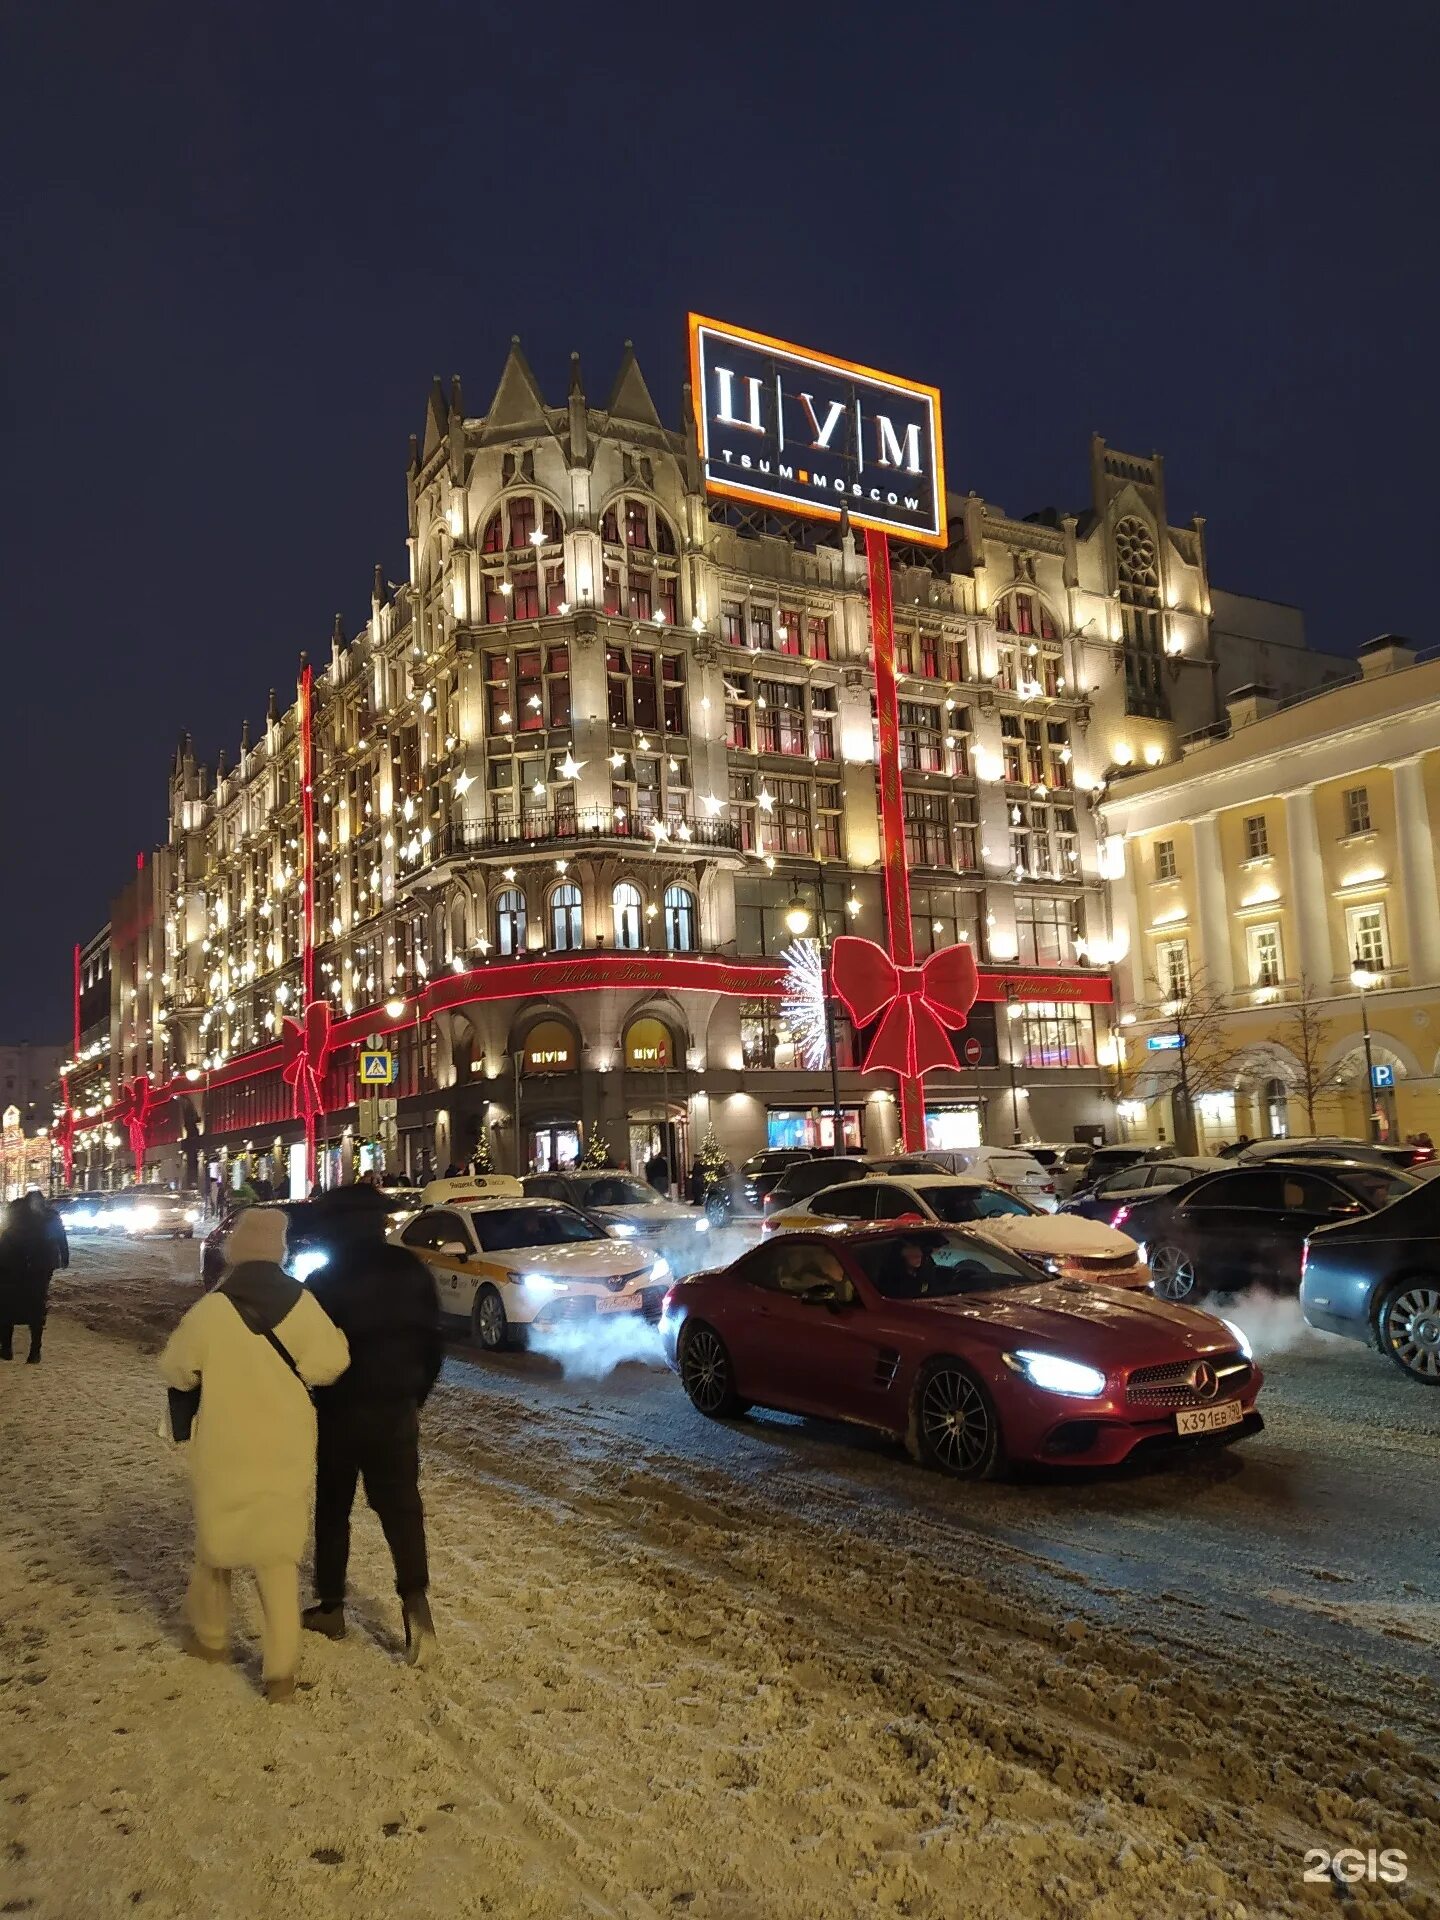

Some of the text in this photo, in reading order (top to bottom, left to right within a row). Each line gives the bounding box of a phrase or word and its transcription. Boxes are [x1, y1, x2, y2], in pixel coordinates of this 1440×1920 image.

[722, 449, 919, 511] TSUM MOSCOW
[1375, 1066, 1390, 1086] P
